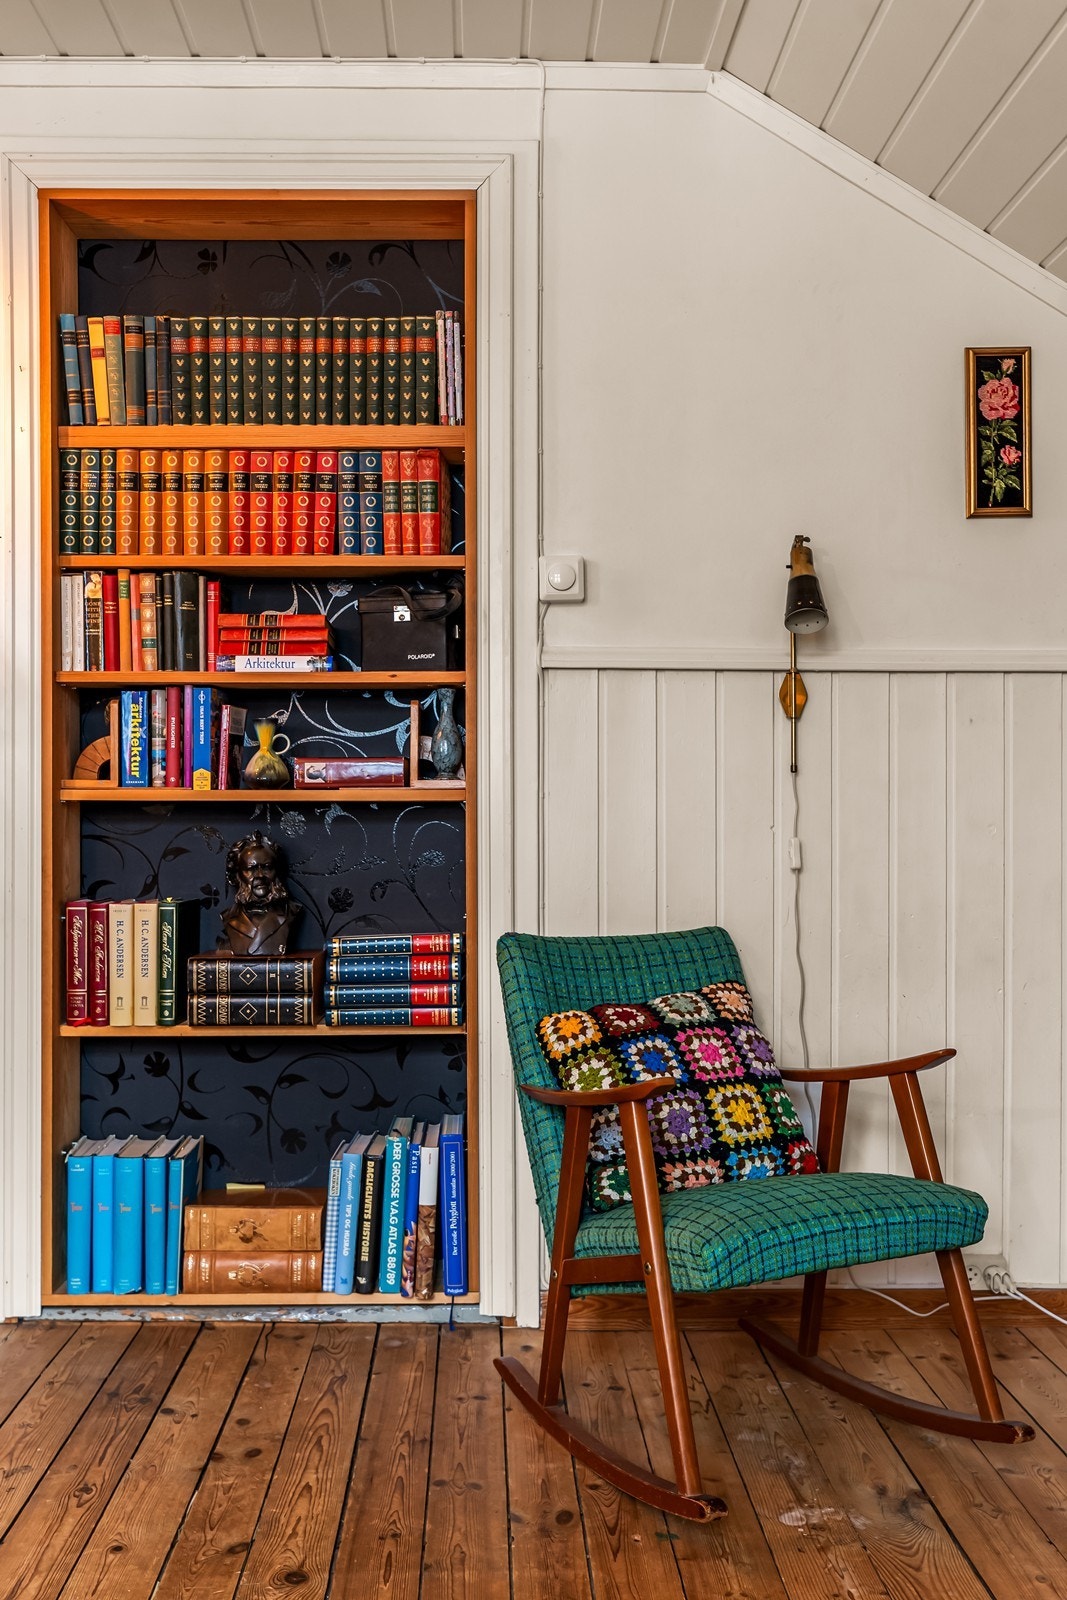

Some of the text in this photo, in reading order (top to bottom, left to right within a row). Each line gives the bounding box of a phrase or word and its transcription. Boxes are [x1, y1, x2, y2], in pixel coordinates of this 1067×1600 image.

[244, 657, 295, 668] Arkitektur
[131, 704, 142, 777] arkitektur
[162, 922, 172, 955] Henrik
[411, 1150, 420, 1174] Pasta
[345, 1220, 350, 1229] OG
[387, 1142, 402, 1285] DER GROSSE V.A.G ATLAS 88/89
[450, 1201, 459, 1228] Polyglott
[361, 1221, 371, 1261] HISTORIE
